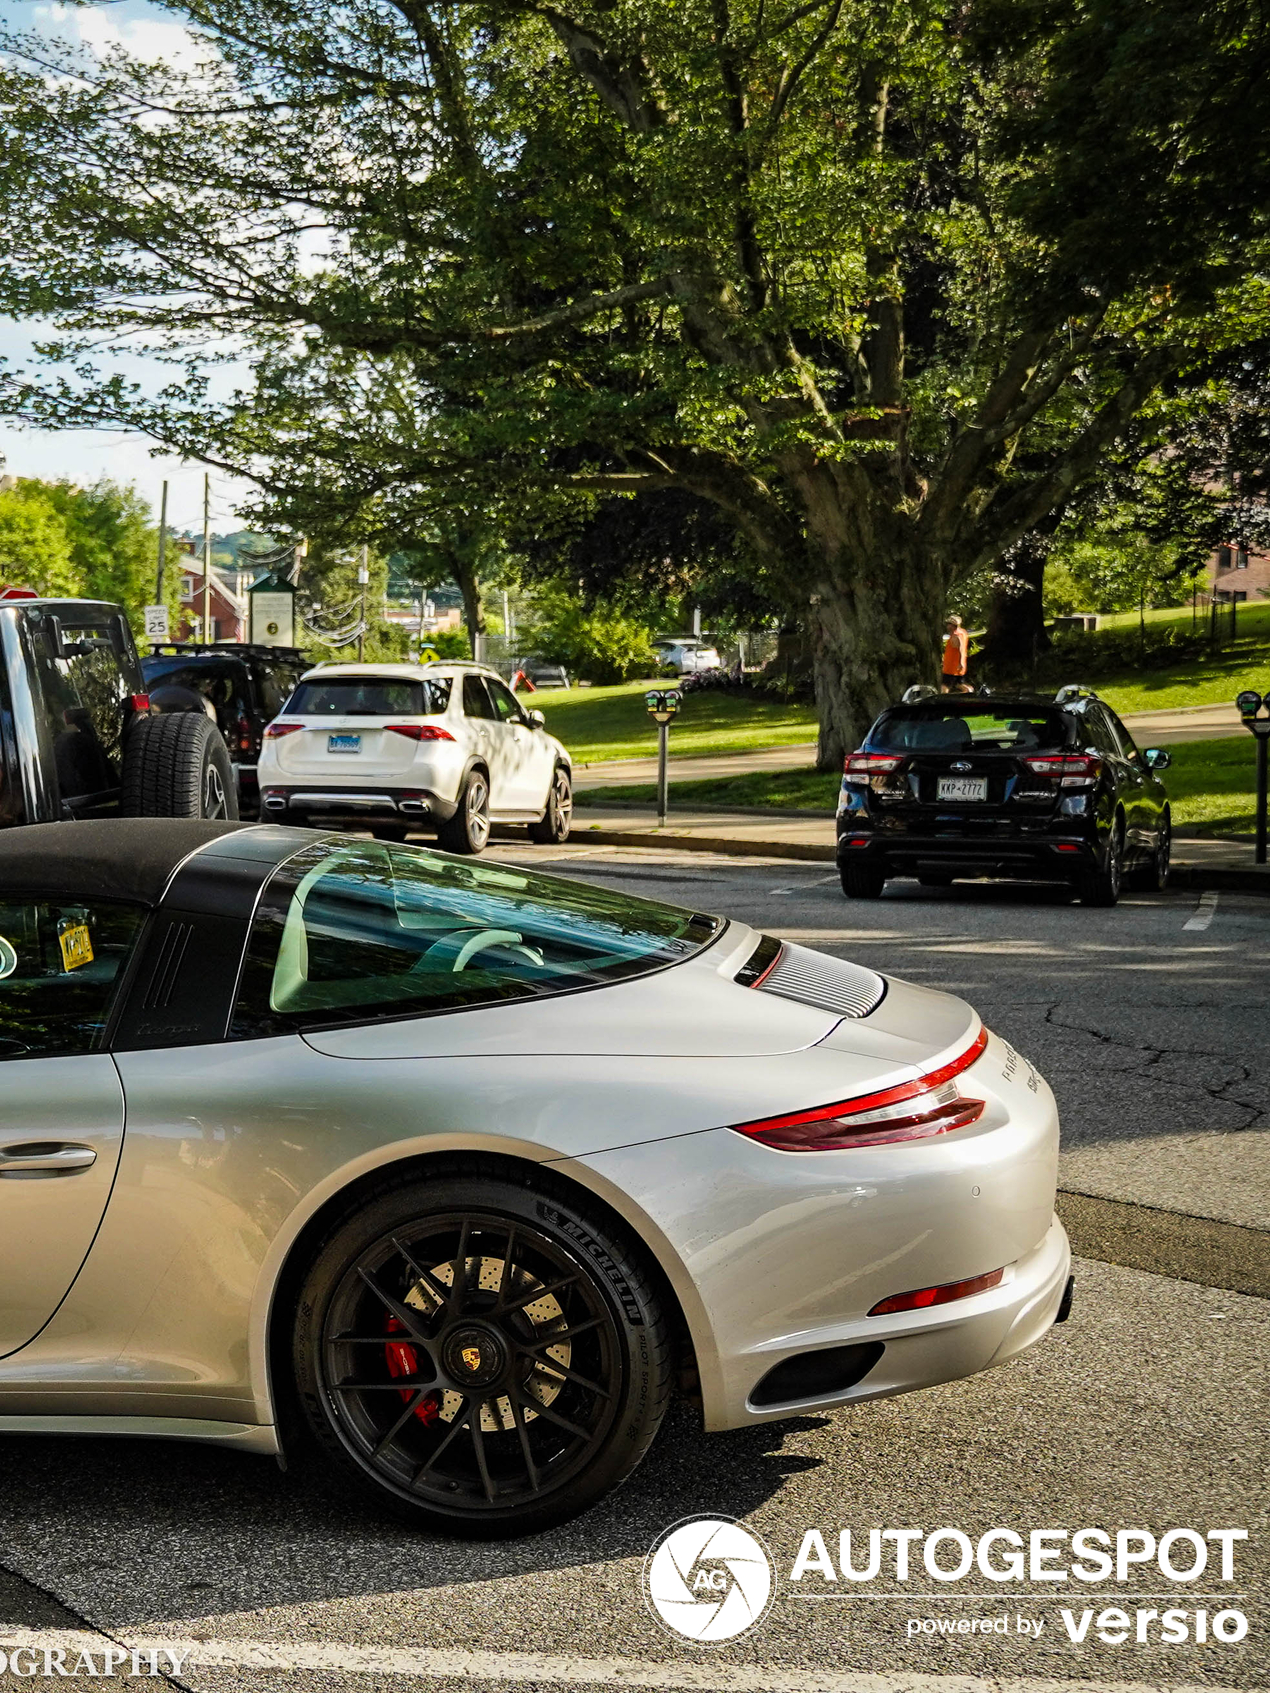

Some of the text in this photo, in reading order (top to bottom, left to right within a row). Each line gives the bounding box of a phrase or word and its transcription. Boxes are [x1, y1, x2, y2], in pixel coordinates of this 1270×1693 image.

[149, 622, 166, 633] 25
[563, 1220, 643, 1320] MICHELIN
[638, 1334, 648, 1367] PILOT
[639, 1371, 649, 1408] SPORT
